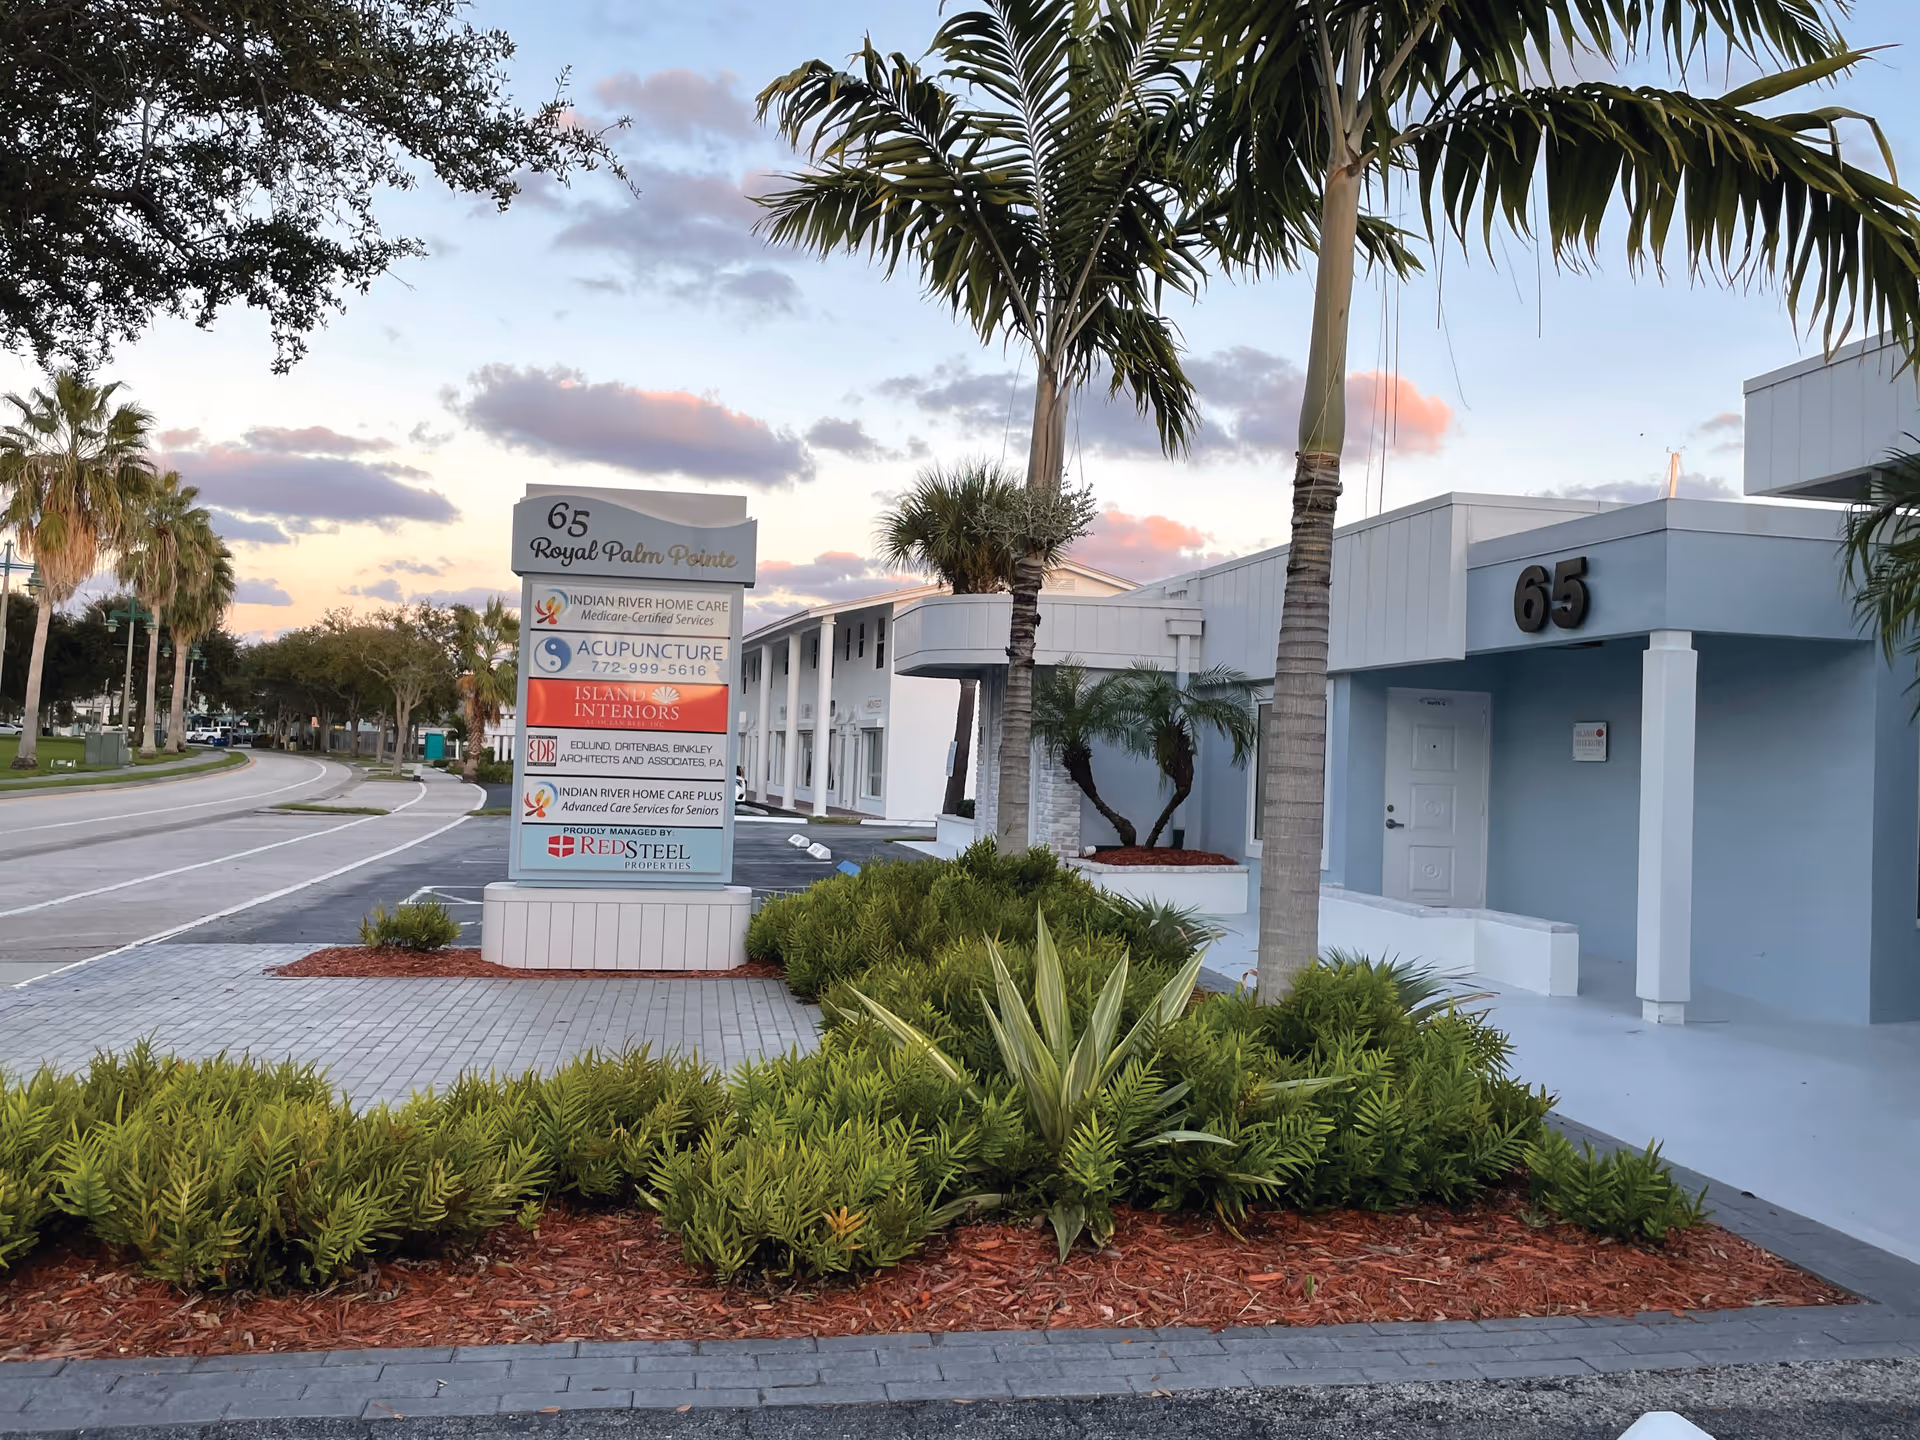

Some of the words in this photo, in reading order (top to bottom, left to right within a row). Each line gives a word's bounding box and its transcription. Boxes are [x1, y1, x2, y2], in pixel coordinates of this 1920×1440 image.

[547, 502, 590, 538] 65
[530, 537, 599, 567] Royal
[602, 540, 664, 565] Palm
[668, 544, 739, 568] Pointe
[1513, 556, 1590, 633] 65
[570, 594, 614, 607] INDIAN
[619, 596, 652, 609] RIVER
[656, 598, 693, 611] HOME
[696, 600, 729, 612] CARE
[580, 610, 673, 625] Medicare-Certified
[675, 613, 714, 626] Services
[577, 640, 723, 661] ACUPUNCTURE
[591, 660, 707, 676] 772-999-5616
[575, 685, 646, 702] ISLAND
[574, 702, 680, 720] INTERIORS
[570, 740, 611, 752] EDLUND,
[615, 742, 670, 754] DRITENBAS,
[673, 744, 713, 754] BINKLEY
[560, 754, 620, 764] ARCHITECTS
[622, 756, 644, 765] AND
[647, 757, 707, 768] ASSOCIATES,
[559, 787, 598, 797] INDIAN
[600, 788, 629, 798] RIVER
[632, 789, 665, 799] HOME
[667, 790, 695, 800] CARE
[697, 791, 723, 801] PLUS
[561, 801, 608, 812] Advanced
[610, 803, 630, 813] Care
[632, 803, 669, 814] Services
[669, 804, 685, 815] for
[686, 805, 719, 816] Seniors
[563, 827, 606, 835] PROUDLY
[609, 828, 657, 836] MANAGED
[624, 861, 691, 870] PROPERTIES
